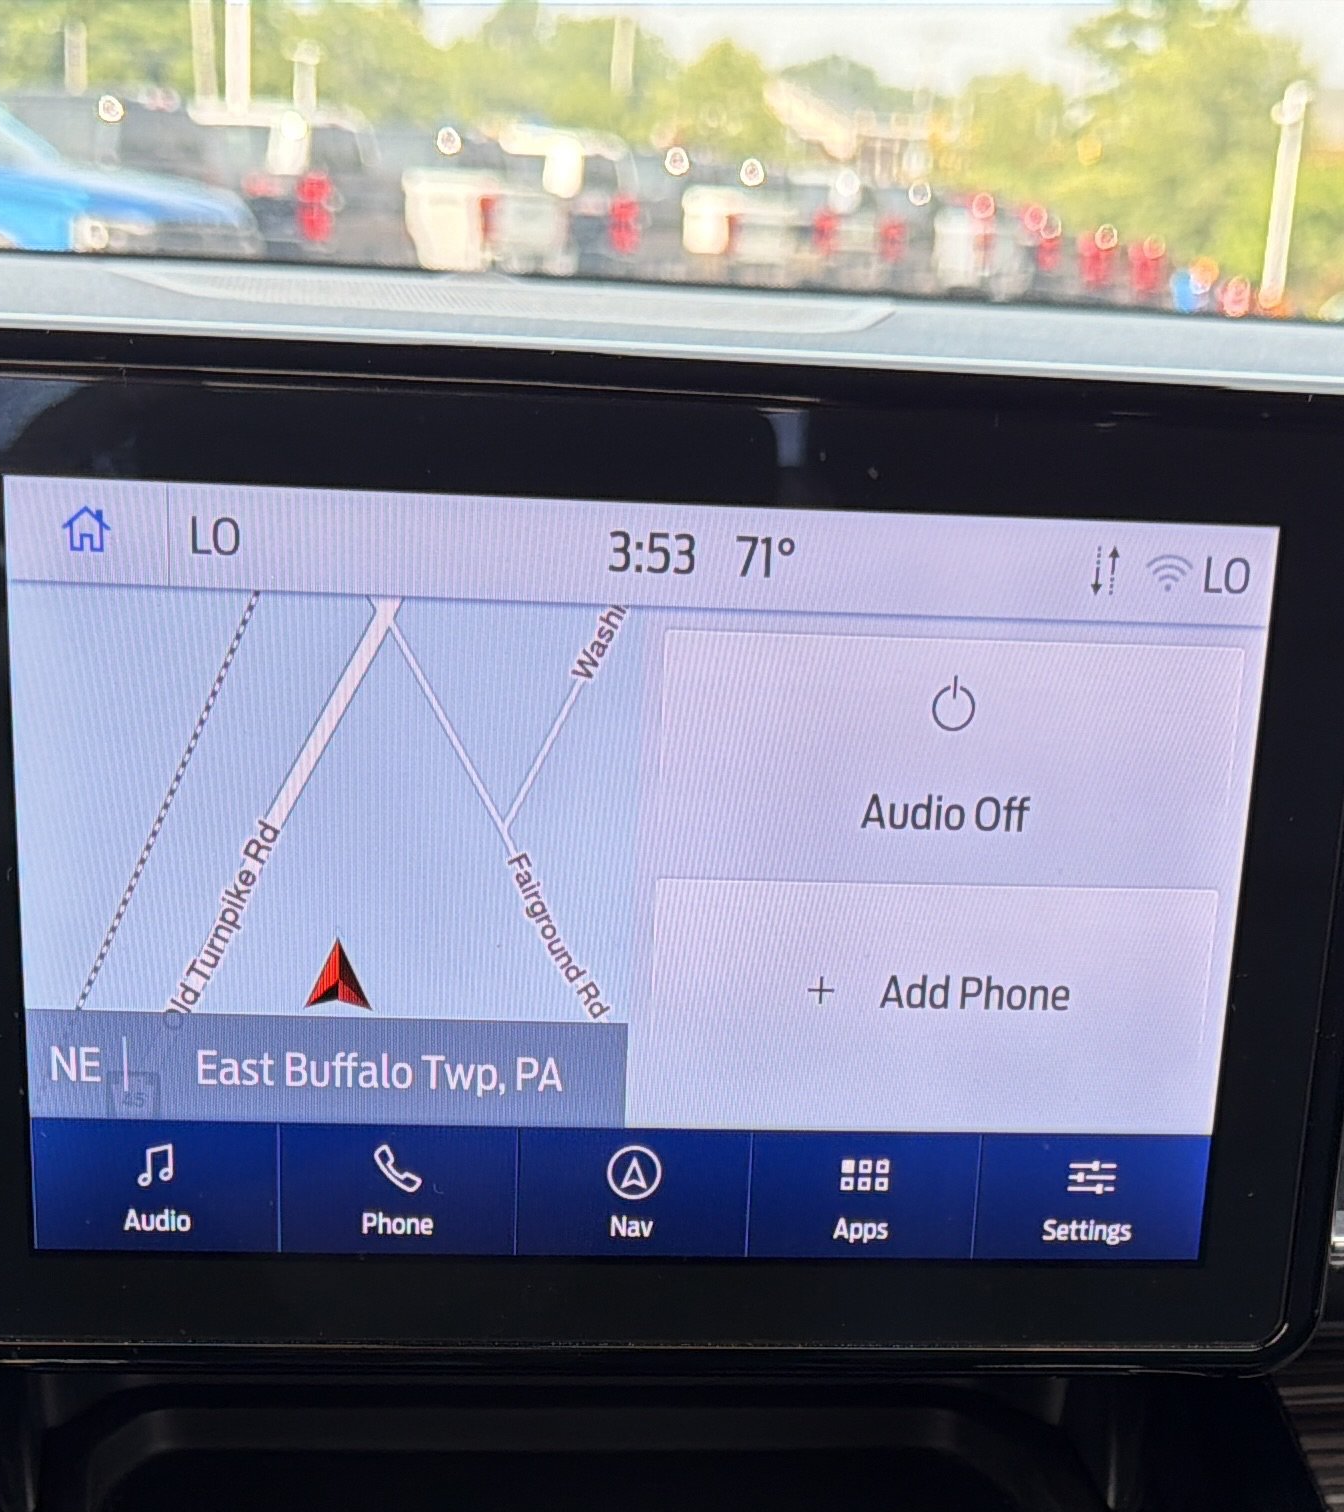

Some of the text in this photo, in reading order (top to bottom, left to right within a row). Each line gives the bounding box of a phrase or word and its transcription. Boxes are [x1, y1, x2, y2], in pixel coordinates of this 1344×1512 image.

[190, 515, 241, 557] LO
[607, 530, 697, 576] 3:53
[735, 535, 796, 578] 71°
[1203, 556, 1251, 595] LO
[861, 793, 1031, 832] Audio Off
[185, 869, 257, 981] Turnpike
[243, 819, 281, 865] Rd
[507, 851, 612, 1020] Fairground Rd
[879, 975, 1071, 1012] Add Phone
[50, 1046, 102, 1082] NE
[197, 1049, 563, 1098] East Buffalo Twp, PA
[123, 1209, 192, 1233] Audio
[361, 1211, 434, 1236] Phone
[609, 1215, 654, 1239] Nav
[832, 1217, 889, 1246] Apps
[1041, 1219, 1133, 1247] Settings
